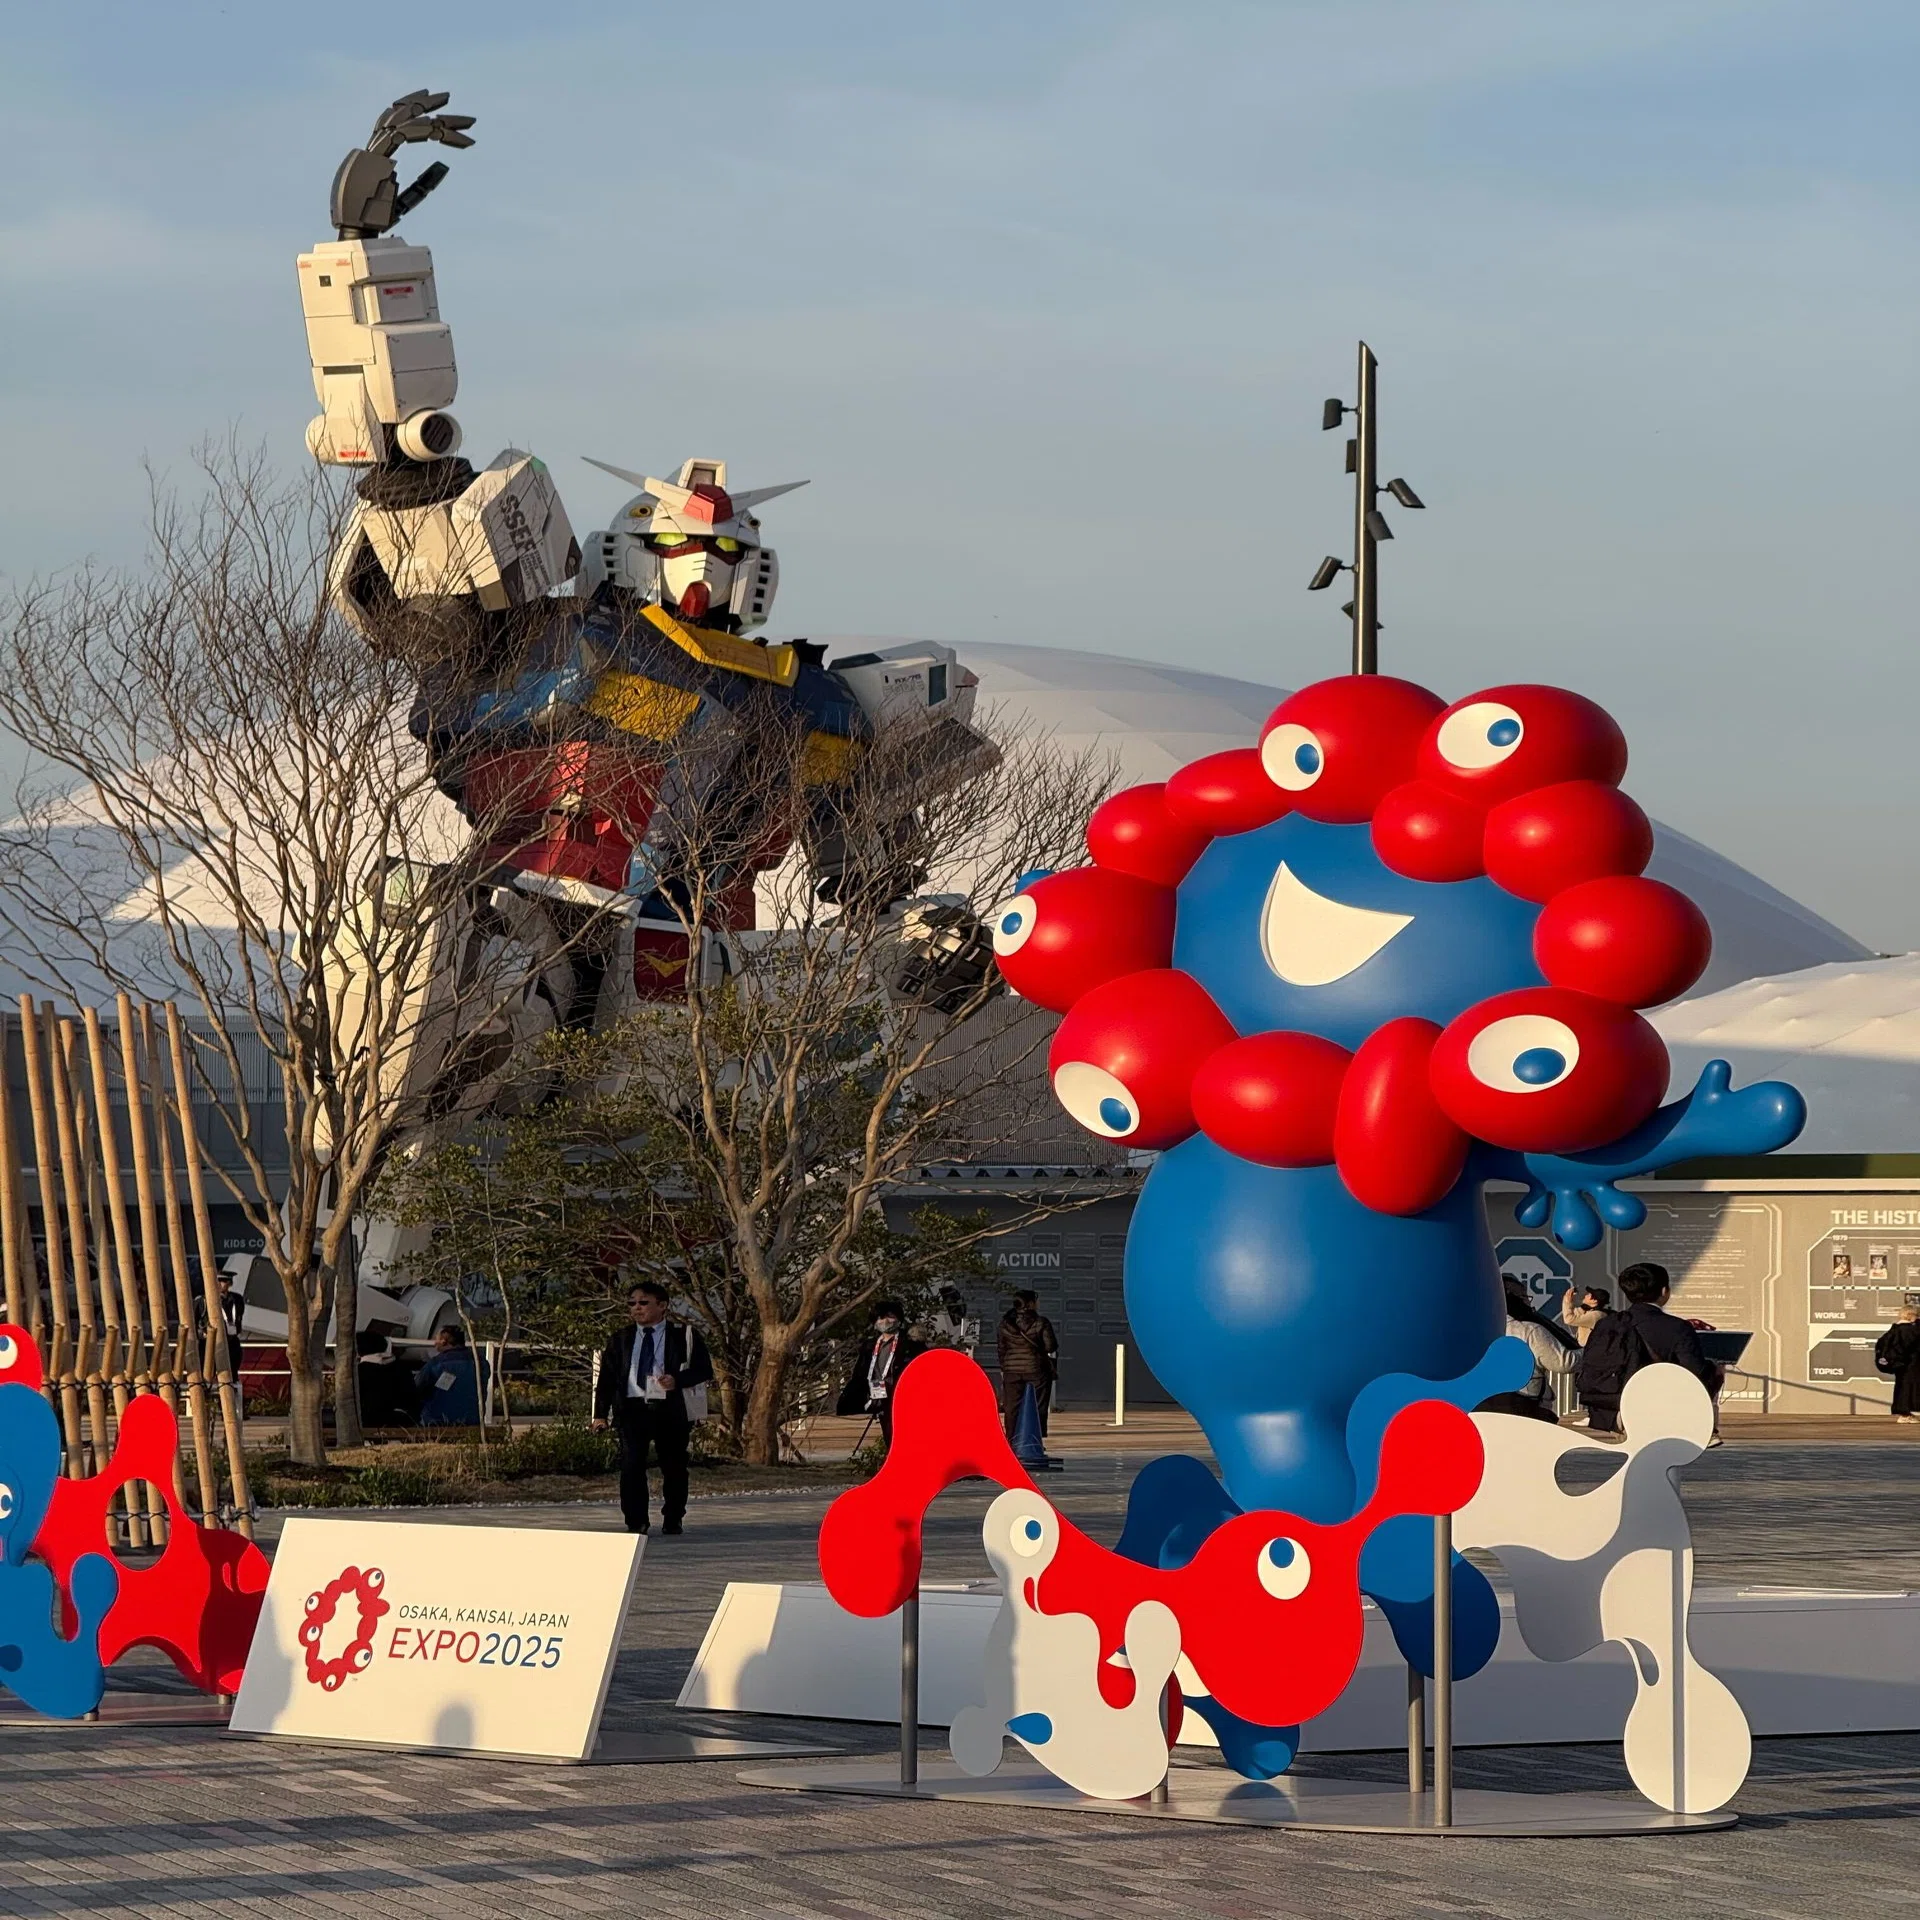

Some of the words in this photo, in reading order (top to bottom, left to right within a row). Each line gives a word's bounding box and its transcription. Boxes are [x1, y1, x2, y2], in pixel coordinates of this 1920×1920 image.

[1831, 1210, 1869, 1225] THE
[1873, 1210, 1920, 1225] HIST
[223, 1239, 247, 1249] KIDS
[997, 1252, 1060, 1267] ACTION
[1813, 1367, 1844, 1375] TOPICS
[399, 1604, 452, 1624] OSAKA,
[455, 1608, 515, 1627] KANSAI,
[519, 1612, 570, 1628] JAPAN
[388, 1627, 563, 1669] EXPO2025
